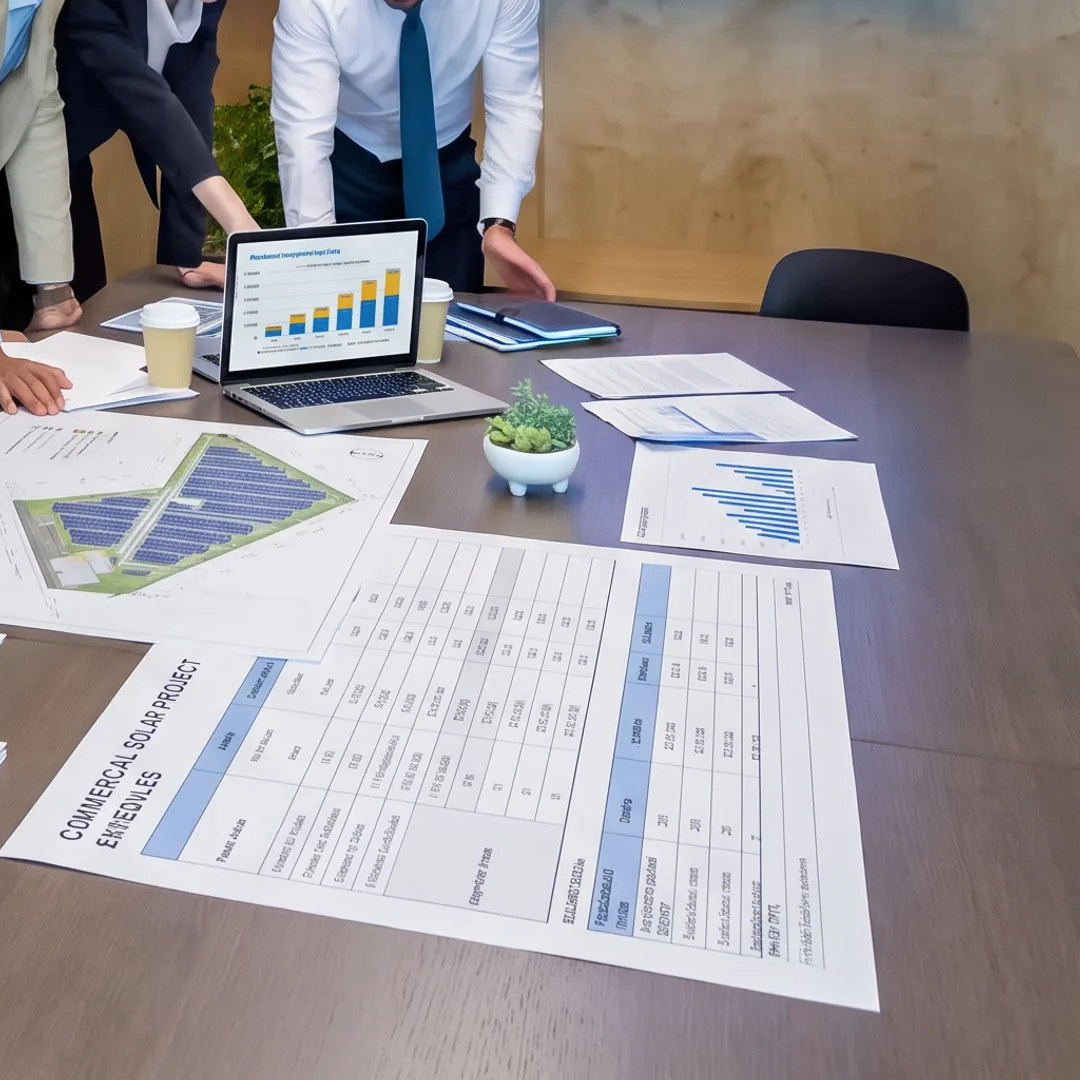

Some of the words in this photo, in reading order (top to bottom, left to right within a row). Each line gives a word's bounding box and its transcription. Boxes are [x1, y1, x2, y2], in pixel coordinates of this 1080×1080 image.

[59, 753, 138, 841] COMMERCAL
[123, 710, 166, 750] SOLAR
[151, 658, 201, 710] PROJECT
